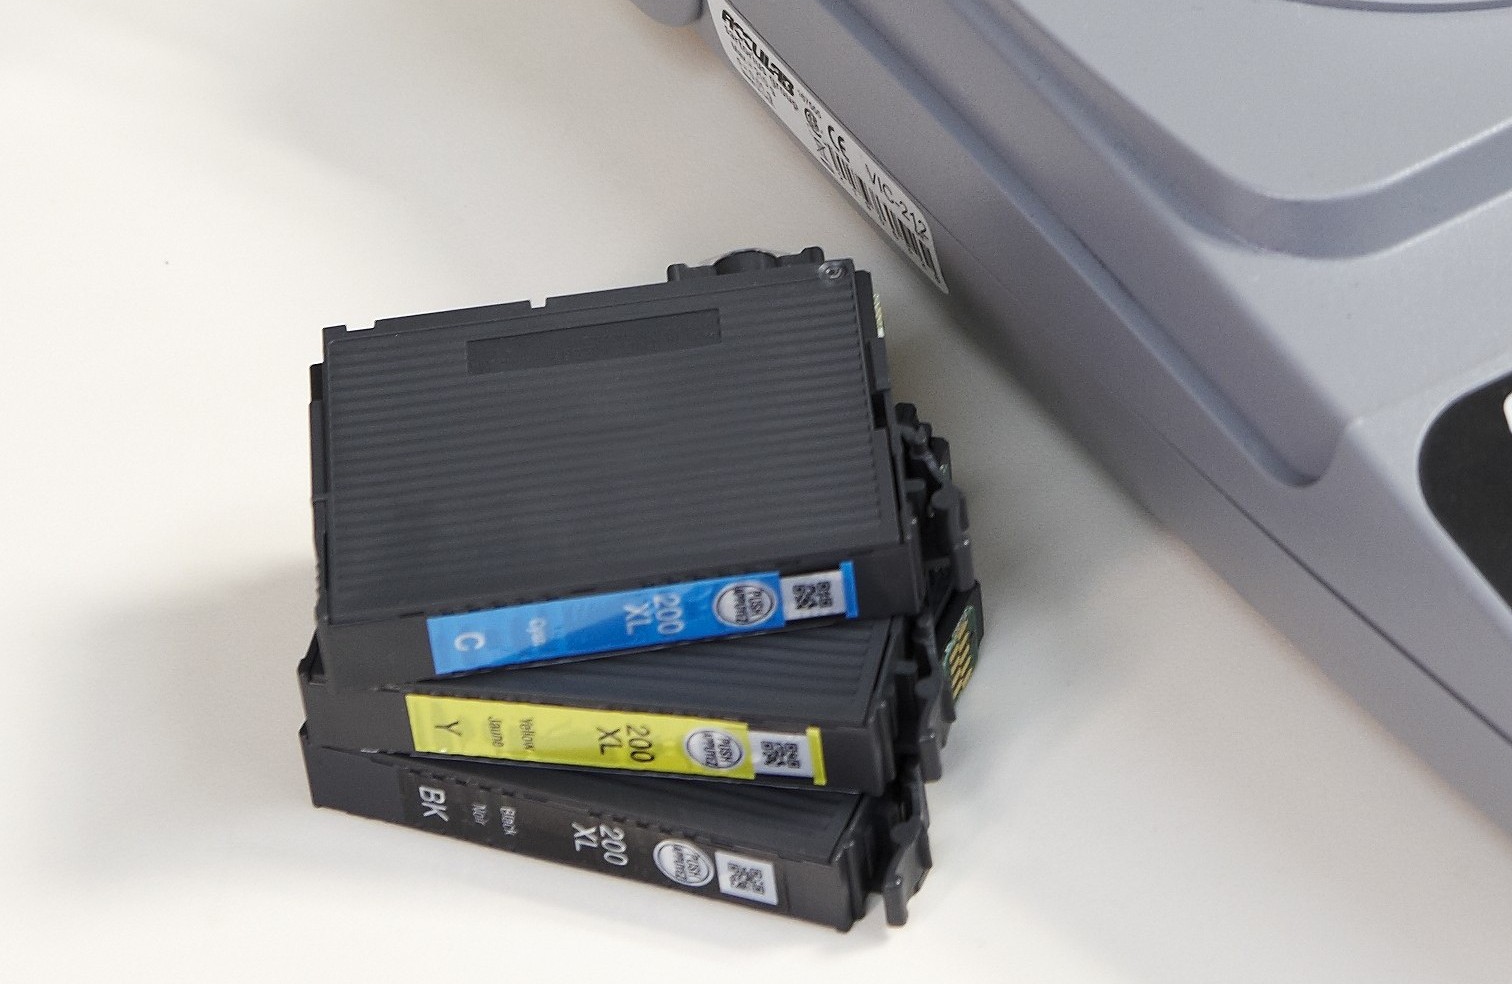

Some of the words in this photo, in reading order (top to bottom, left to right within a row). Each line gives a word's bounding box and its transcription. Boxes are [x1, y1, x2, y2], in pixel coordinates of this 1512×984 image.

[623, 600, 652, 636] XL
[652, 591, 685, 636] 200
[453, 631, 486, 652] C
[434, 719, 463, 736] Y
[487, 716, 505, 748] Jaune
[596, 725, 623, 756] XL
[626, 723, 656, 764] 200
[418, 785, 449, 823] BK
[571, 821, 599, 852] XL
[600, 823, 629, 867] 200
